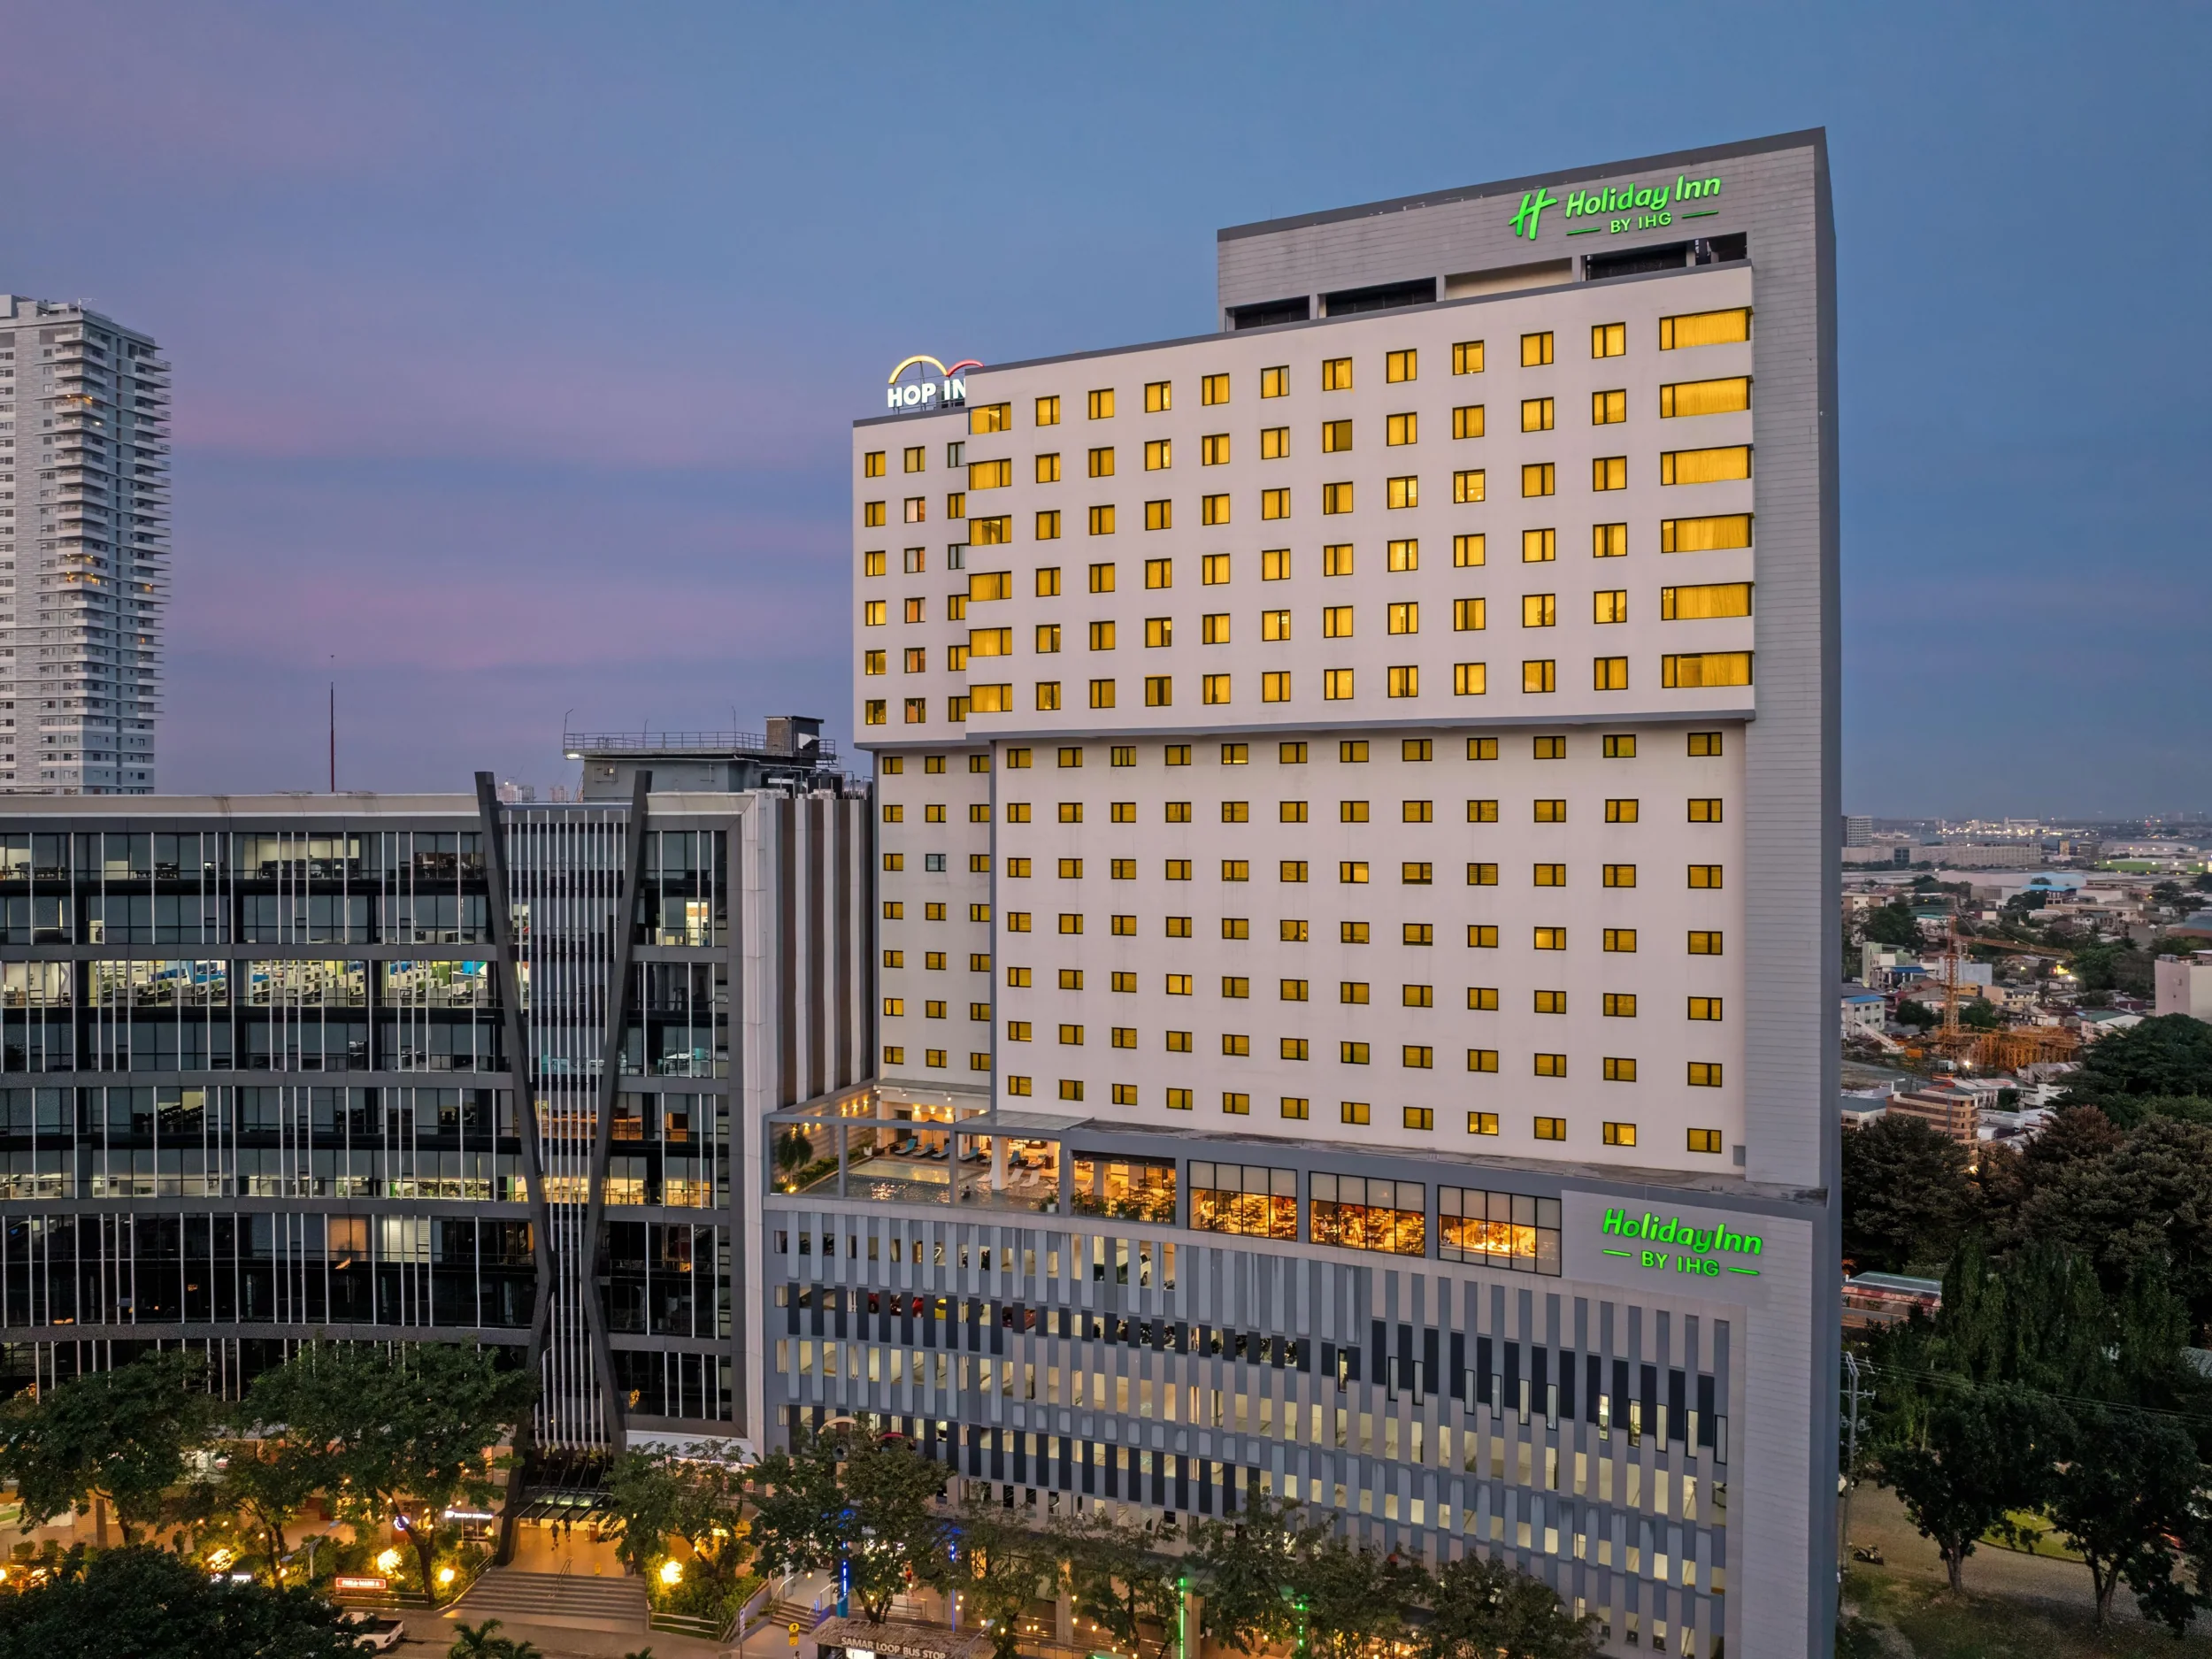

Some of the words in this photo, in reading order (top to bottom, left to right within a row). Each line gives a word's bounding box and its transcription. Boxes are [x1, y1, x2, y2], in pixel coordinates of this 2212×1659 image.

[1565, 182, 1670, 219] Holiday
[1675, 174, 1721, 203] Inn
[1610, 218, 1632, 234] BY
[1638, 211, 1672, 231] IHG
[887, 382, 937, 409] HOP
[1640, 1249, 1670, 1270] BY
[1677, 1255, 1720, 1277] IHG
[841, 1636, 874, 1649] SAMAR
[875, 1641, 901, 1654] LOOP
[902, 1647, 920, 1657] BUS
[922, 1649, 947, 1659] STOP
